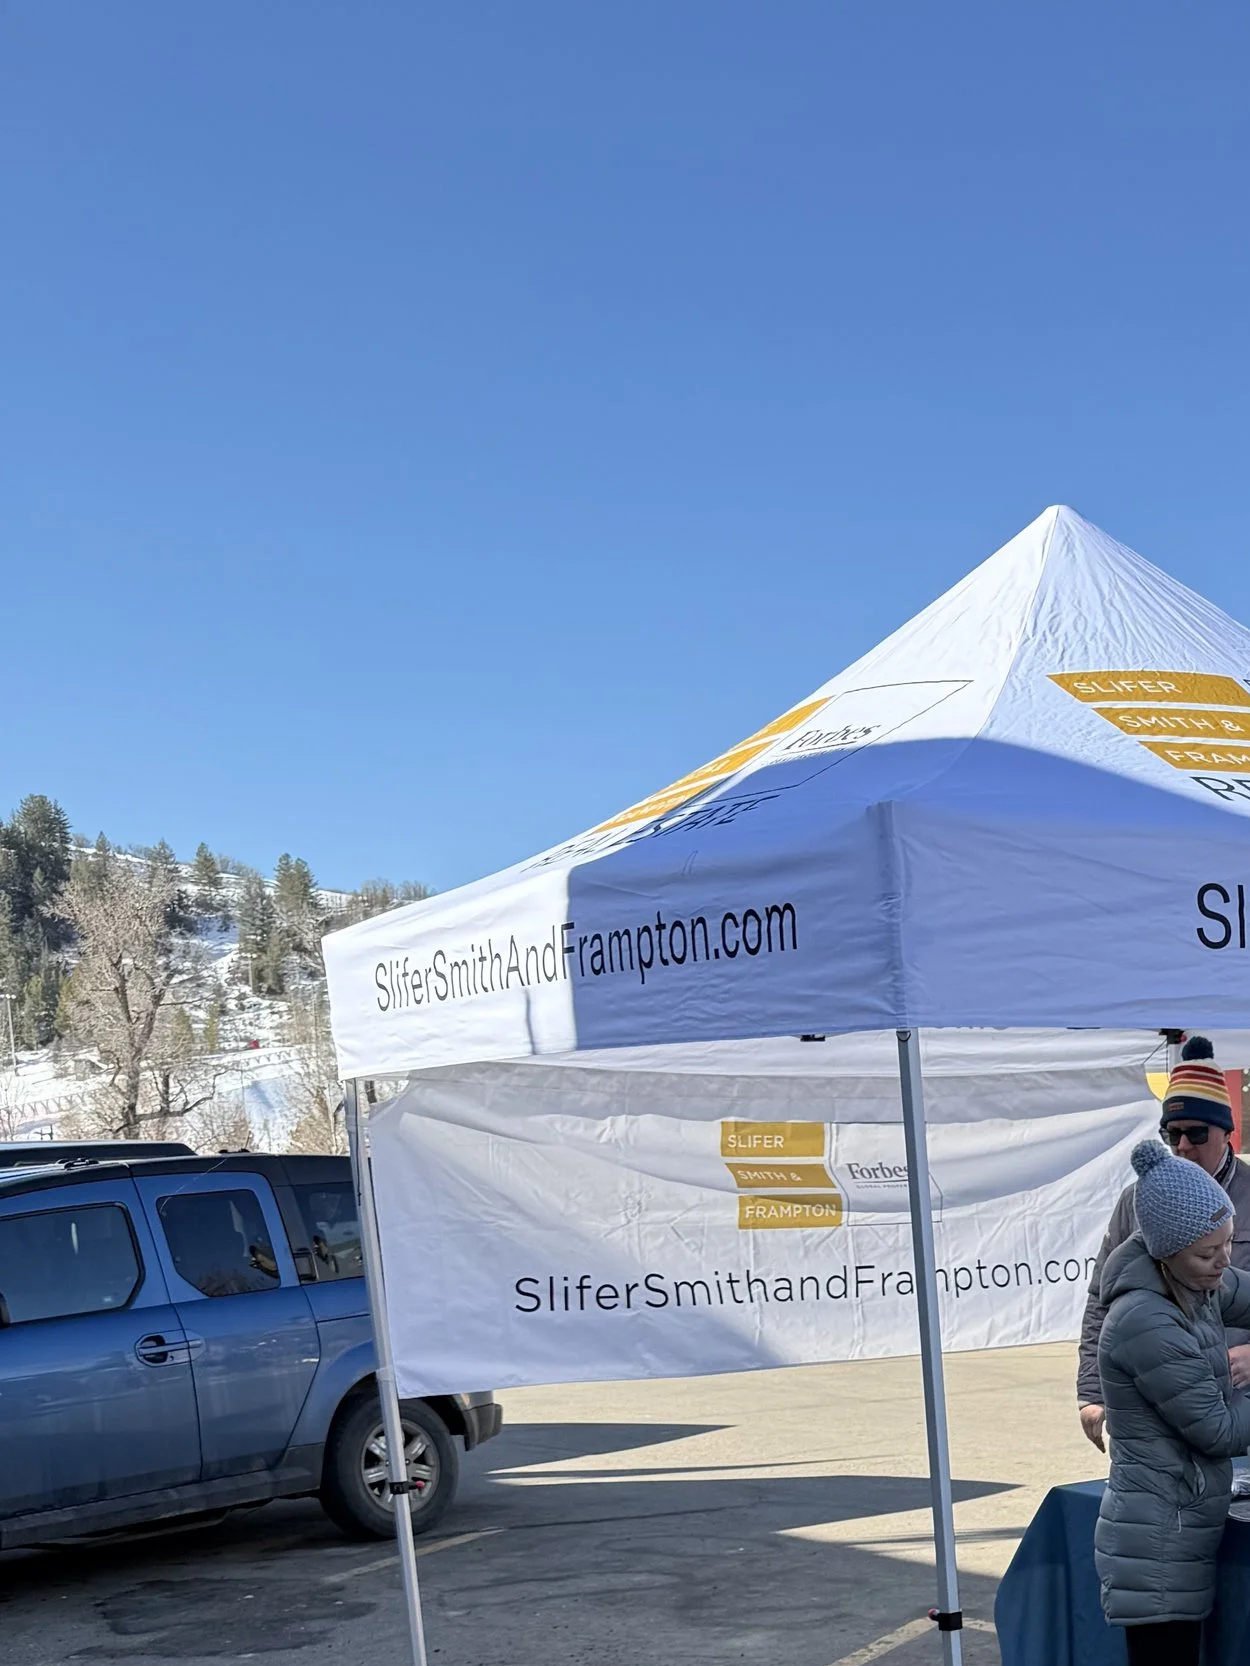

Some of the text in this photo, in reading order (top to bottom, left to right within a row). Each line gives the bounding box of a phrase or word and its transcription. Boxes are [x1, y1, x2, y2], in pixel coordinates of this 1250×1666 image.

[1073, 680, 1182, 694] SLIFER
[1118, 715, 1246, 733] SMITH &
[374, 901, 799, 1013] SliferSmithAndFrampton.com
[727, 1134, 785, 1149] SLIFER
[736, 1169, 788, 1181] SMITH
[744, 1203, 837, 1219] FRAMPTON
[514, 1256, 1098, 1314] SliferSmithandFrapton.co
